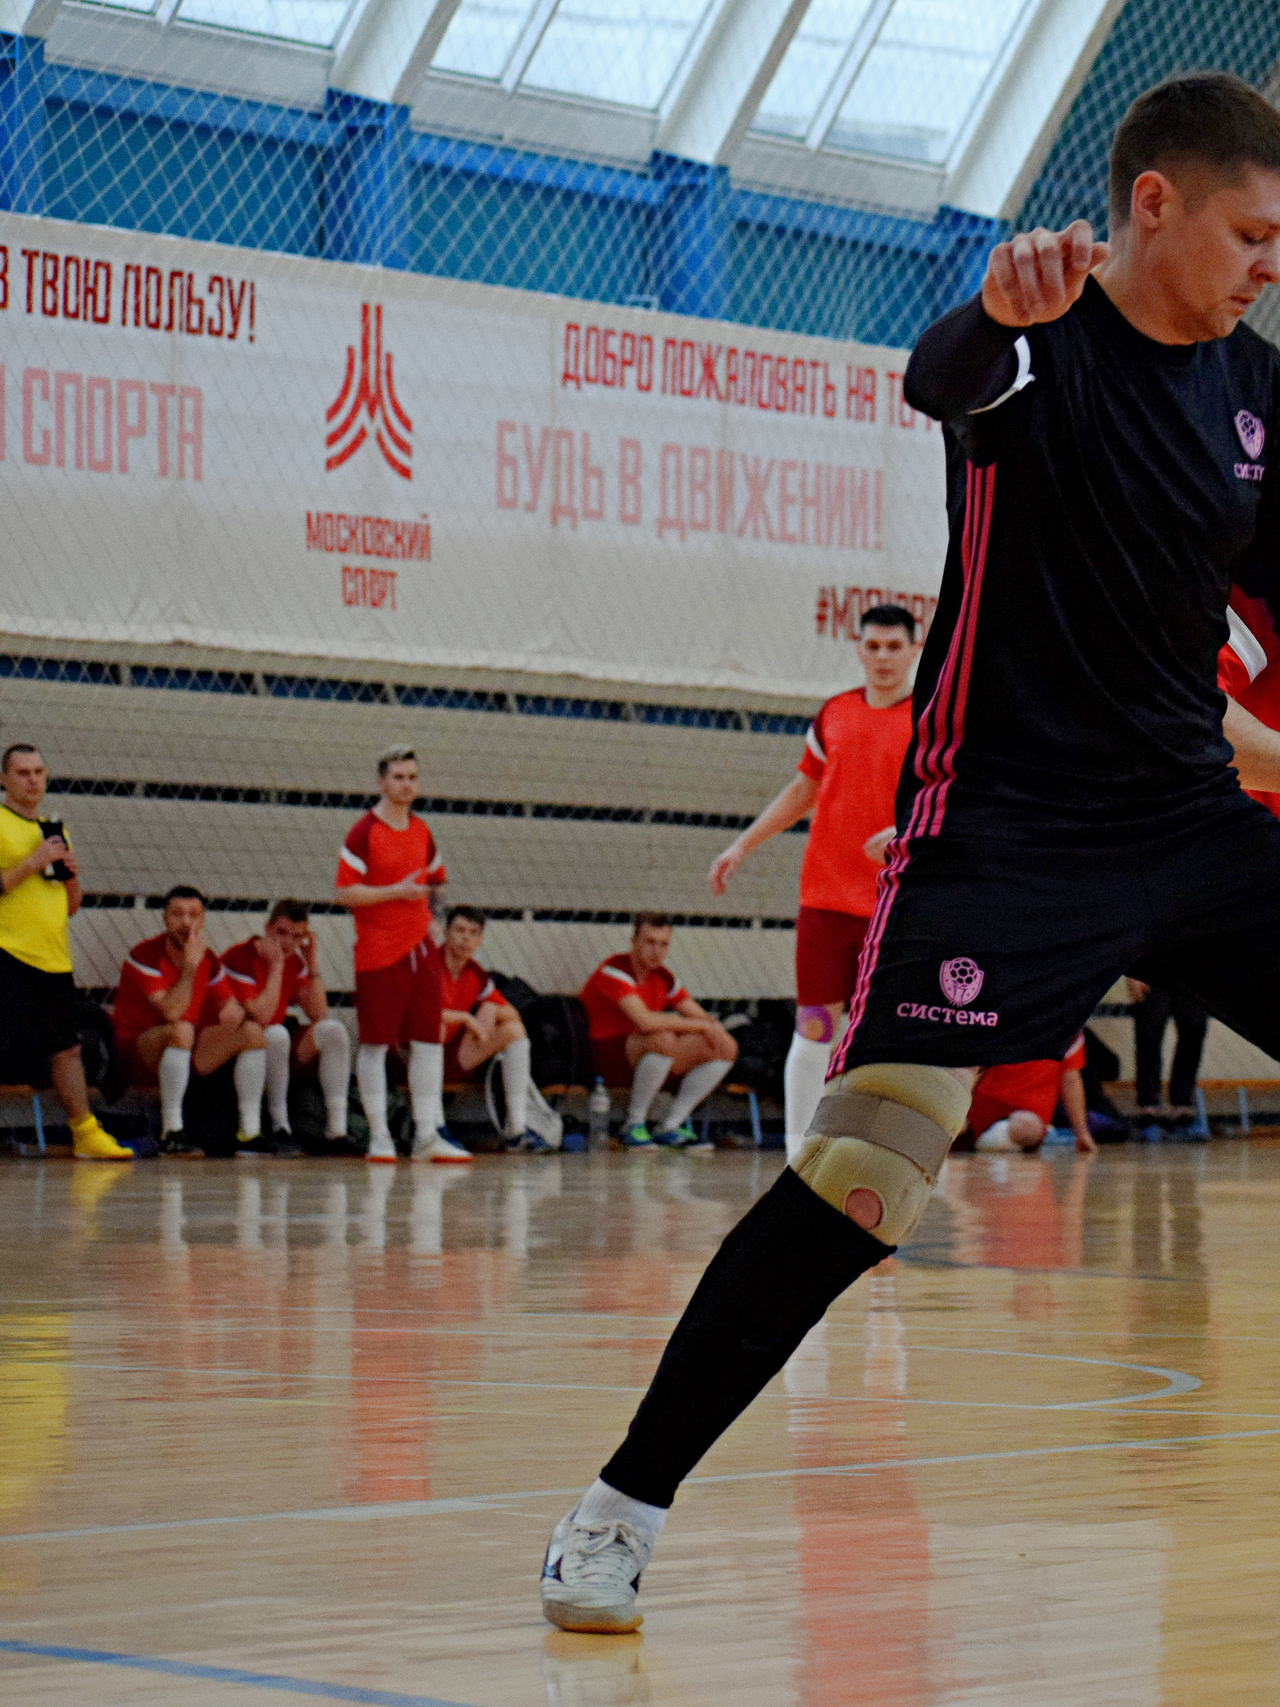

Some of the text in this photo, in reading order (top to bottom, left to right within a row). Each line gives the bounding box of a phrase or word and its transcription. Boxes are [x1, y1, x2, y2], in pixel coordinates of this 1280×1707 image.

[21, 248, 112, 324] ТВОЮ
[121, 263, 256, 343] ПОЛЬЗУ!
[561, 322, 653, 392] ДОБРО
[660, 337, 837, 418] ПОЖАЛОВАТЬ
[846, 364, 876, 423] НА
[22, 367, 203, 482] СПОРТА
[496, 419, 883, 552] БУДЬ В ДВИЖЕНИИ!
[305, 510, 432, 562] МОСКОВСКИЙ
[341, 565, 397, 611] СПОРТ
